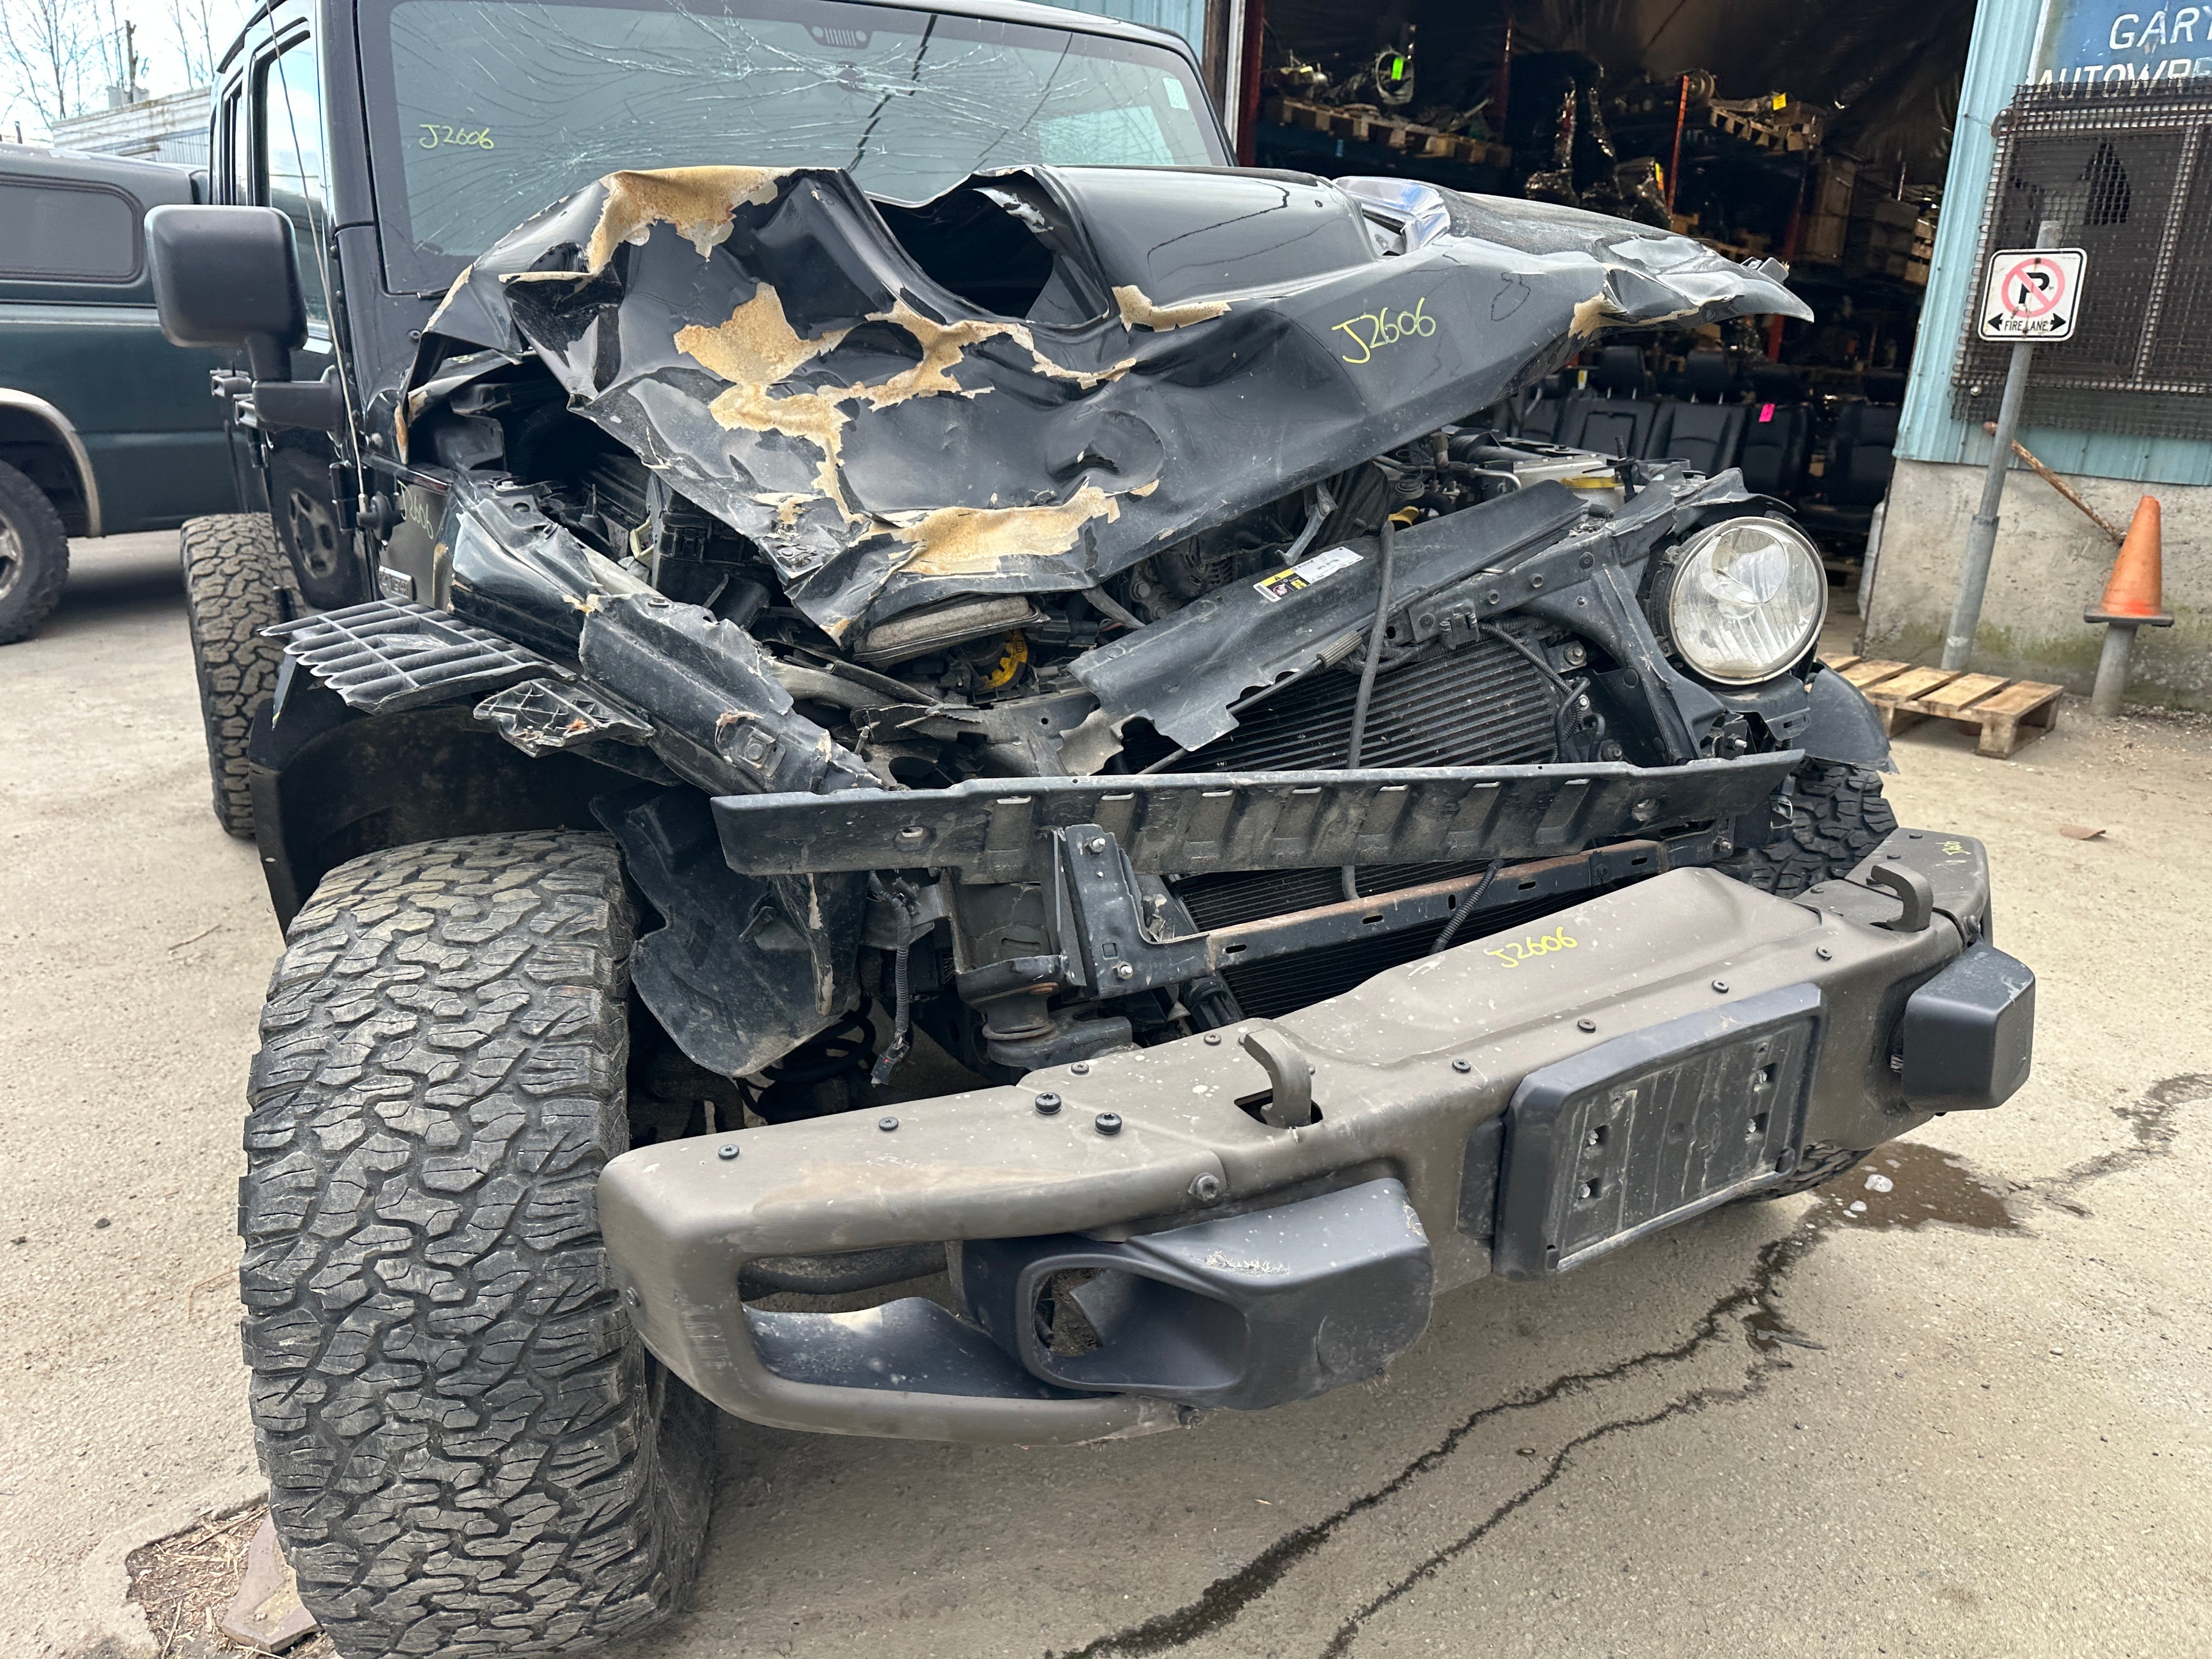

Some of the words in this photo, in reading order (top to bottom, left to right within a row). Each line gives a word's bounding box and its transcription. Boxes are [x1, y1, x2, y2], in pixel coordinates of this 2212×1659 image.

[419, 124, 494, 149] J2606
[1331, 297, 1436, 363] J2606
[2004, 320, 2024, 331] FIRE
[1483, 926, 1578, 968] J2606
